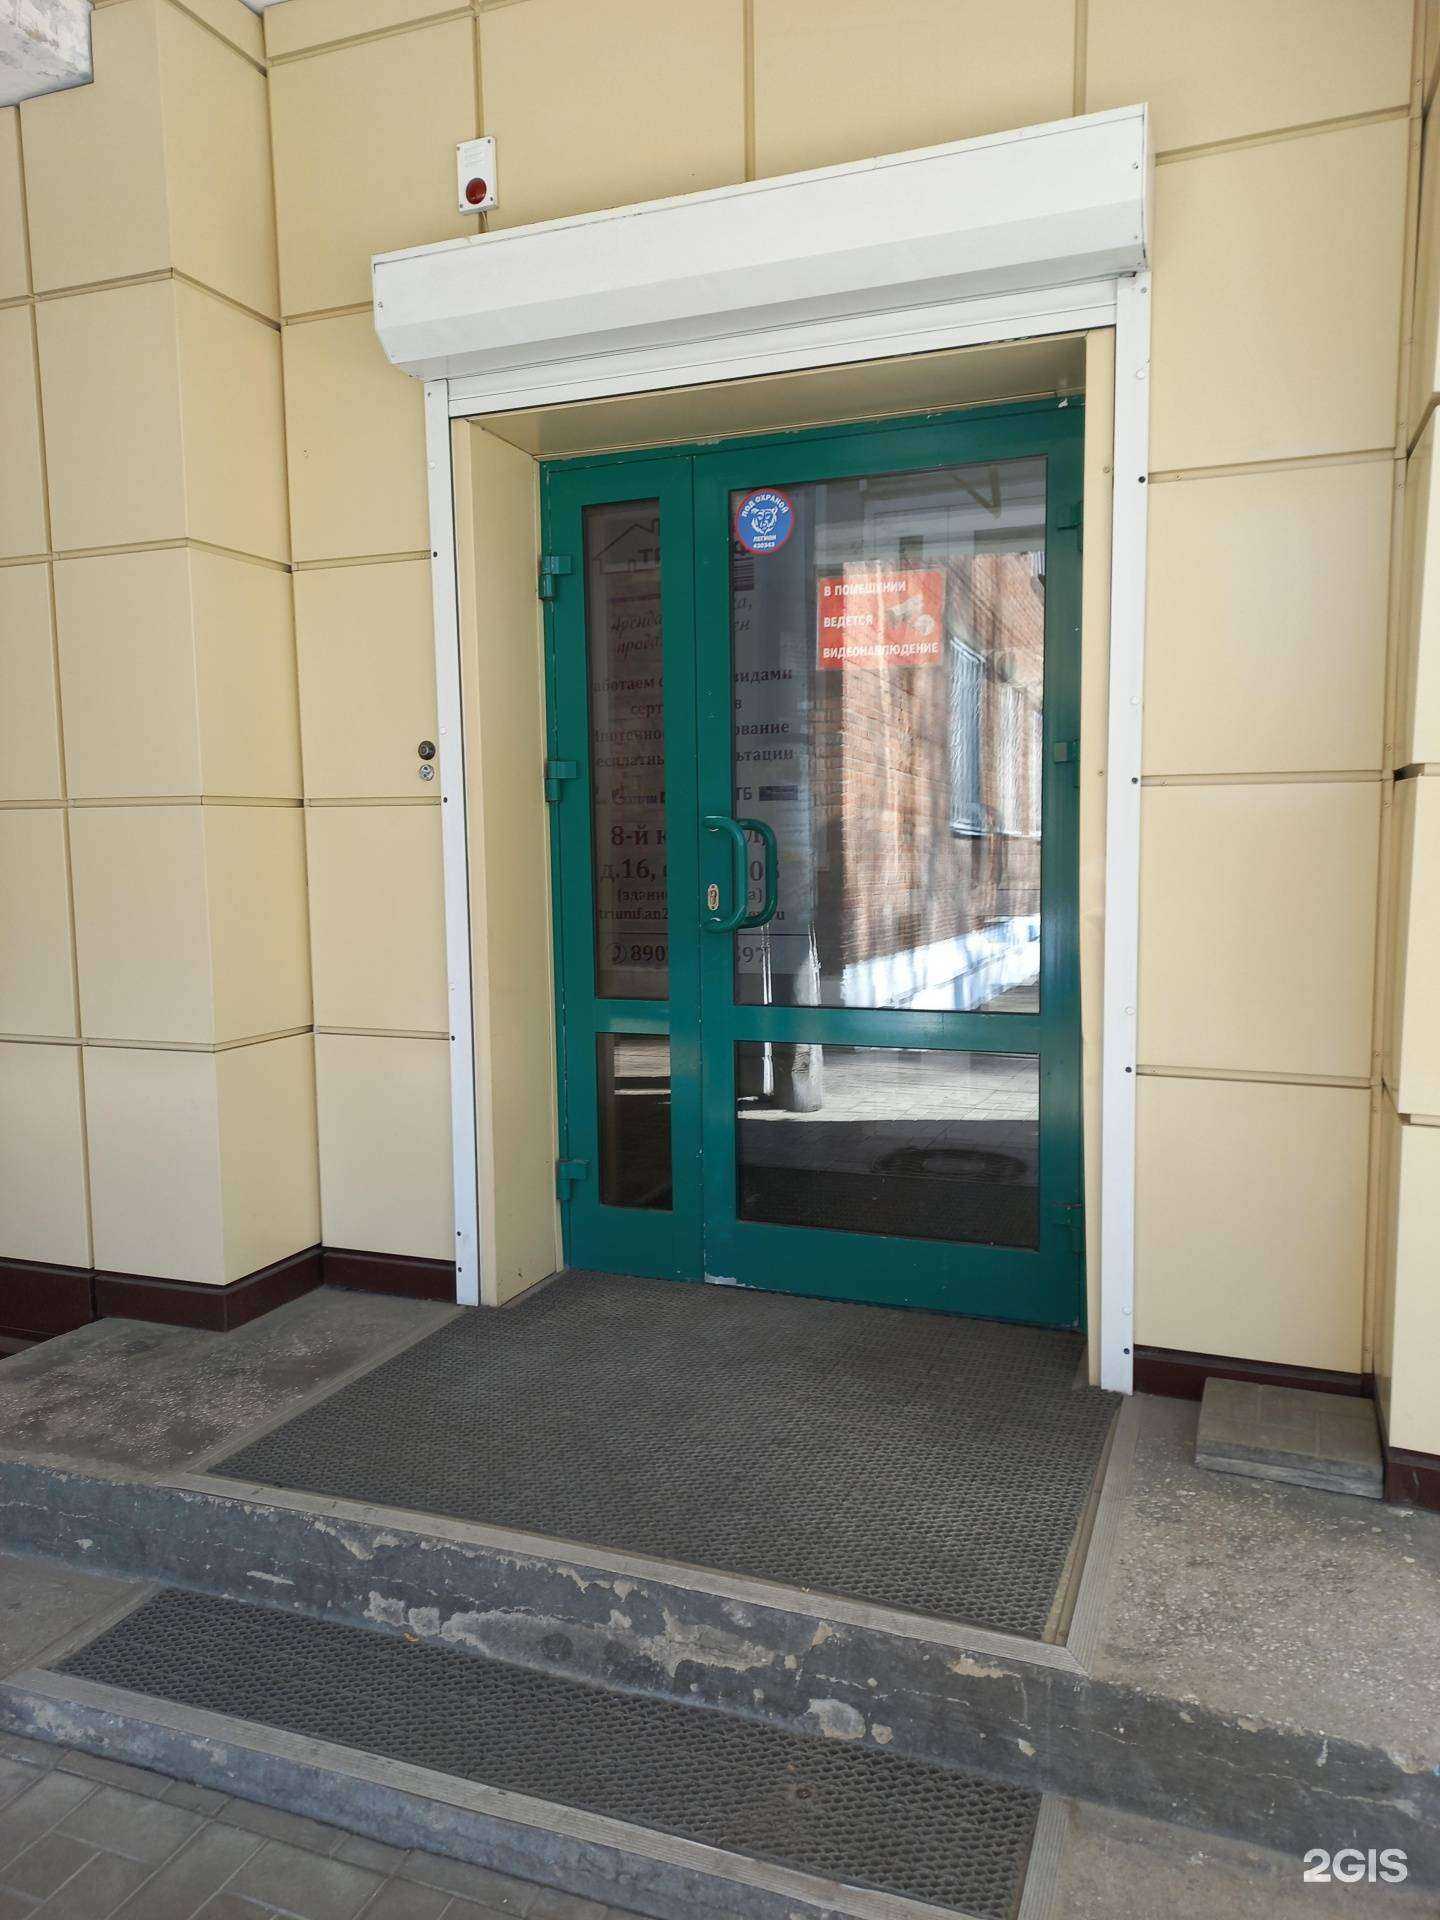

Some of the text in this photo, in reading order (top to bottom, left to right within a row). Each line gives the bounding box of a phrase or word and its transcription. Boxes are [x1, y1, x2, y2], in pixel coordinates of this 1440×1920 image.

[741, 494, 790, 518] ПОД ОХРАНОЙ
[823, 585, 831, 597] В
[736, 749, 793, 764] ьтации
